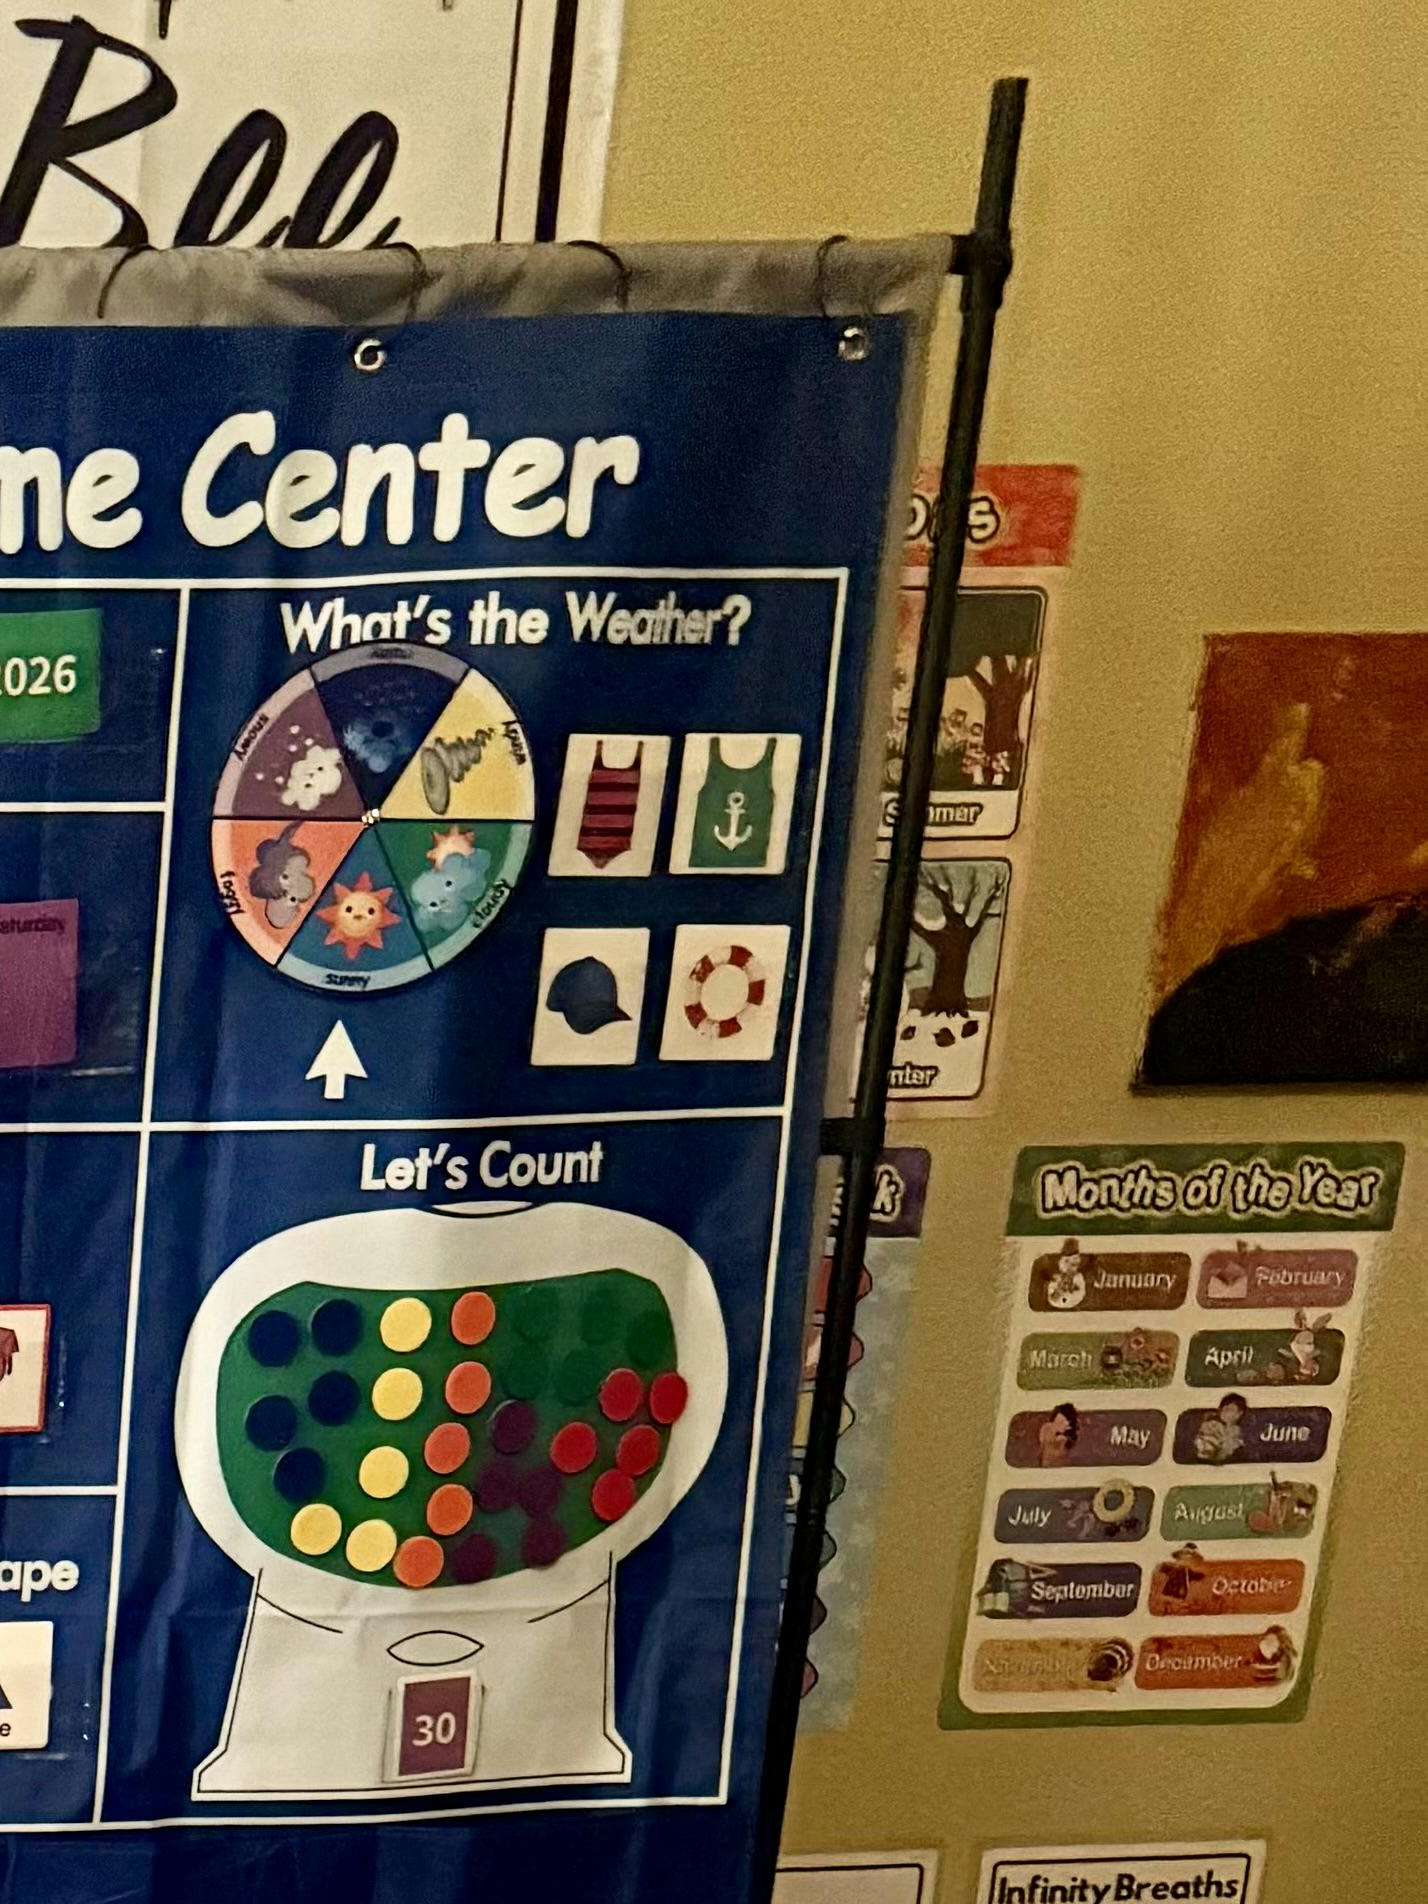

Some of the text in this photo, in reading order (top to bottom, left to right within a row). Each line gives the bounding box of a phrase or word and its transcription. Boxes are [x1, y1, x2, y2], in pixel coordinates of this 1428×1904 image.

[181, 410, 639, 547] Center
[281, 590, 752, 652] What's the Weather?
[233, 713, 270, 762] snowy
[360, 1140, 606, 1191] Let's Count
[1041, 1161, 1381, 1216] Months of the Year
[1093, 1266, 1344, 1292] January February
[1028, 1344, 1254, 1370] March April
[1109, 1422, 1310, 1450] May June
[1007, 1501, 1244, 1528] July August
[1030, 1579, 1135, 1604] September
[1144, 1651, 1244, 1674] December
[410, 1713, 458, 1748] 30
[1114, 1874, 1241, 1902] Breaths
